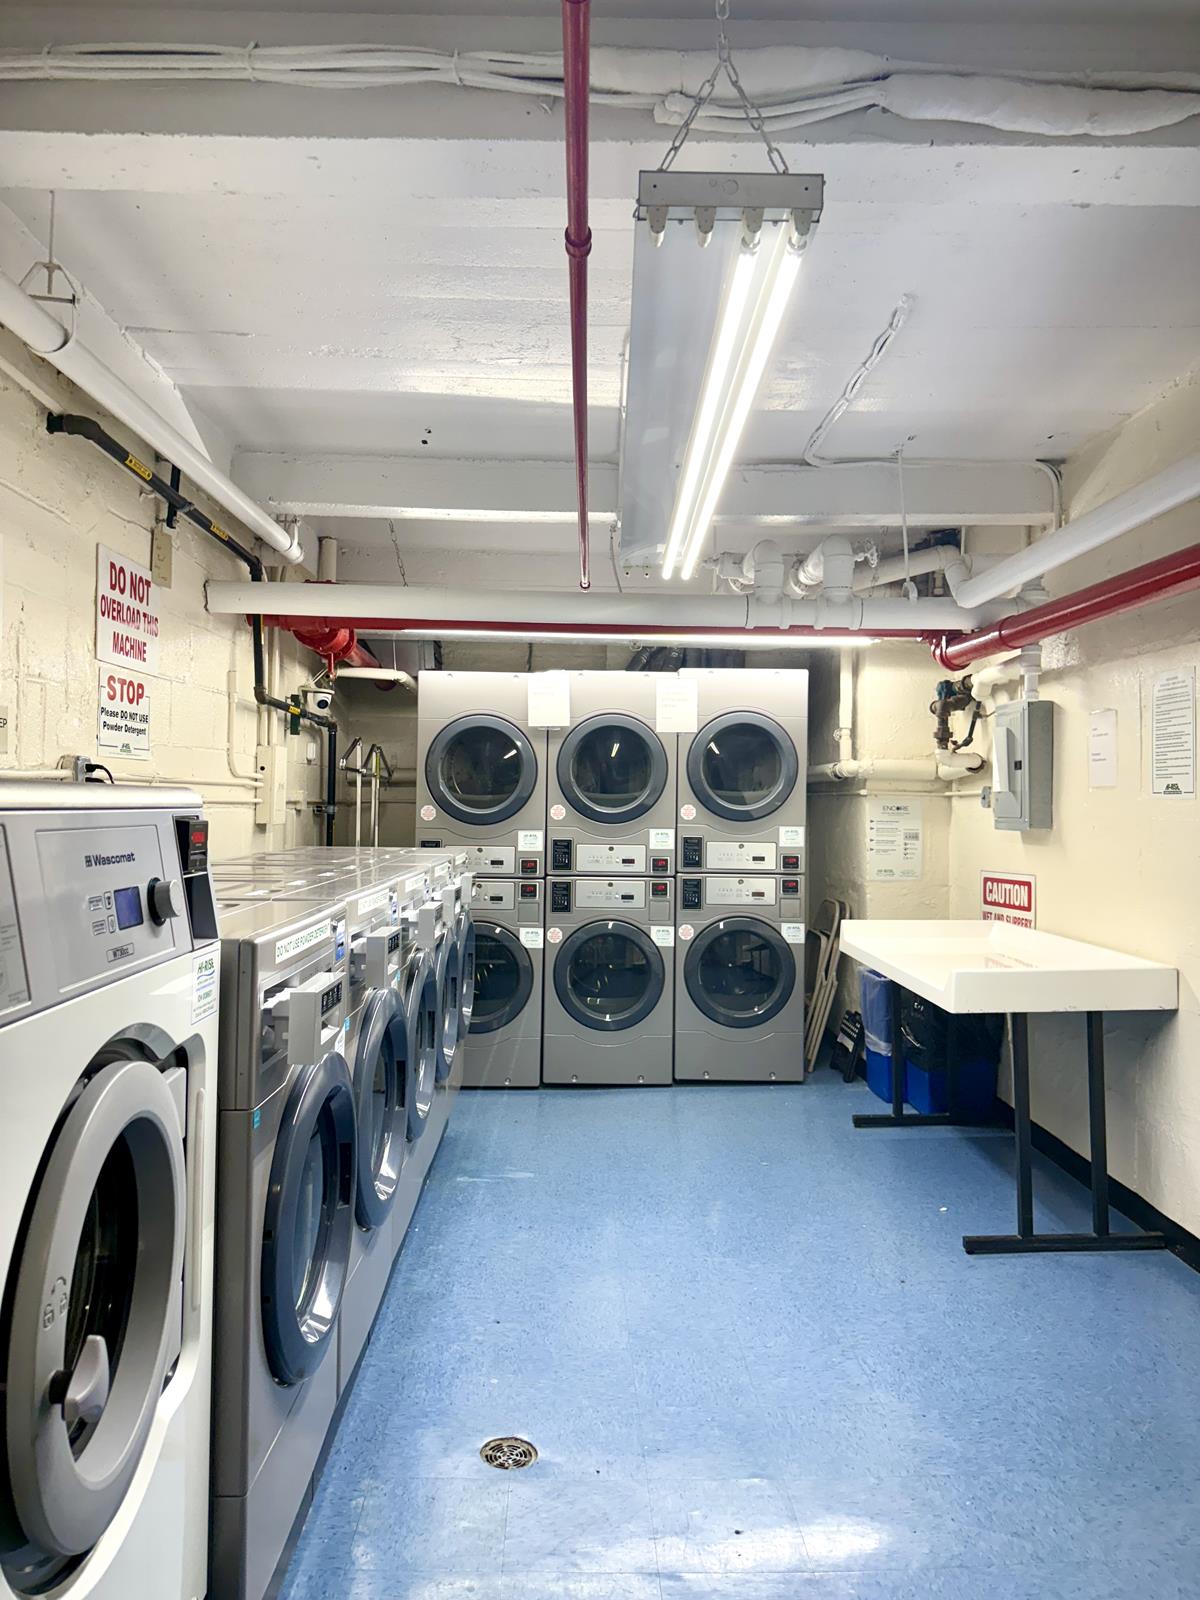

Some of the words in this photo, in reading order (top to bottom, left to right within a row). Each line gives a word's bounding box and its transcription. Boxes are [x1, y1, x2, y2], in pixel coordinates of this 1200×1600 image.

[109, 561, 126, 595] DO
[130, 571, 151, 606] NOT
[100, 594, 140, 630] OVERLOAD
[142, 612, 158, 637] THIS
[112, 631, 147, 662] MACHINE
[107, 675, 144, 705] STOP
[101, 707, 119, 718] Please
[120, 710, 128, 720] DO
[129, 712, 138, 721] NOT
[139, 714, 149, 723] USE
[103, 721, 123, 732] Powder
[124, 724, 146, 736] Detergent
[91, 852, 136, 866] Wascomat
[986, 880, 1028, 907] CAUTION
